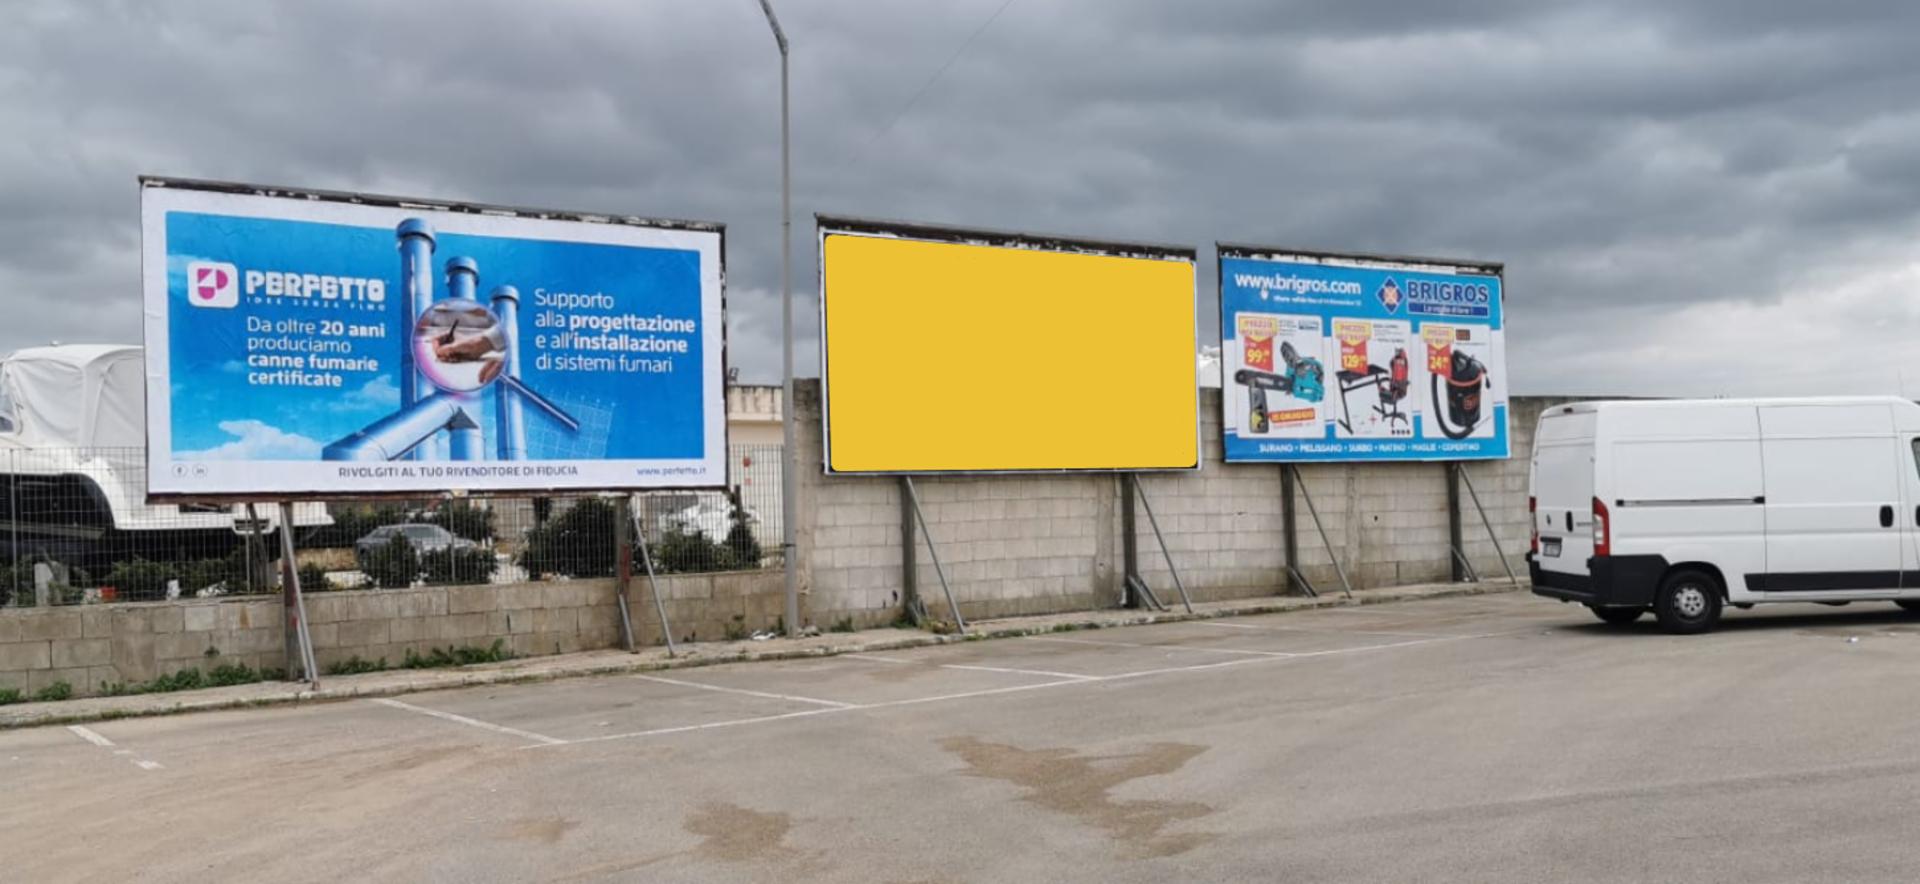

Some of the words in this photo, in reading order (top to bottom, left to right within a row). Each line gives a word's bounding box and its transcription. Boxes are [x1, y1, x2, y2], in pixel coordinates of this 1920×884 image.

[246, 270, 385, 302] PERFETTO
[1234, 273, 1361, 294] www.brigros.com
[1408, 281, 1488, 303] BRIGROS
[534, 288, 615, 309] Supporto
[247, 316, 271, 332] Da
[277, 319, 316, 335] oltre
[320, 320, 344, 336] 20
[349, 323, 385, 338] anni
[535, 310, 565, 328] alla
[569, 313, 695, 333] progettazione
[248, 335, 352, 353] produciamo
[535, 334, 546, 349] e
[551, 332, 688, 353] all'installazione
[248, 354, 304, 368] canne
[309, 354, 378, 371] fumarie
[536, 353, 551, 370] di
[555, 354, 616, 371] sistemi
[619, 354, 673, 372] fumari
[248, 370, 342, 387] certificate
[338, 466, 398, 478] RIVOLGITI
[401, 467, 416, 477] AL
[420, 466, 444, 477] TUO
[446, 466, 521, 477] RIVENDITORE
[523, 466, 534, 476] DI
[536, 465, 578, 476] FIDUCIA
[636, 466, 706, 476] www.perfetto.it
